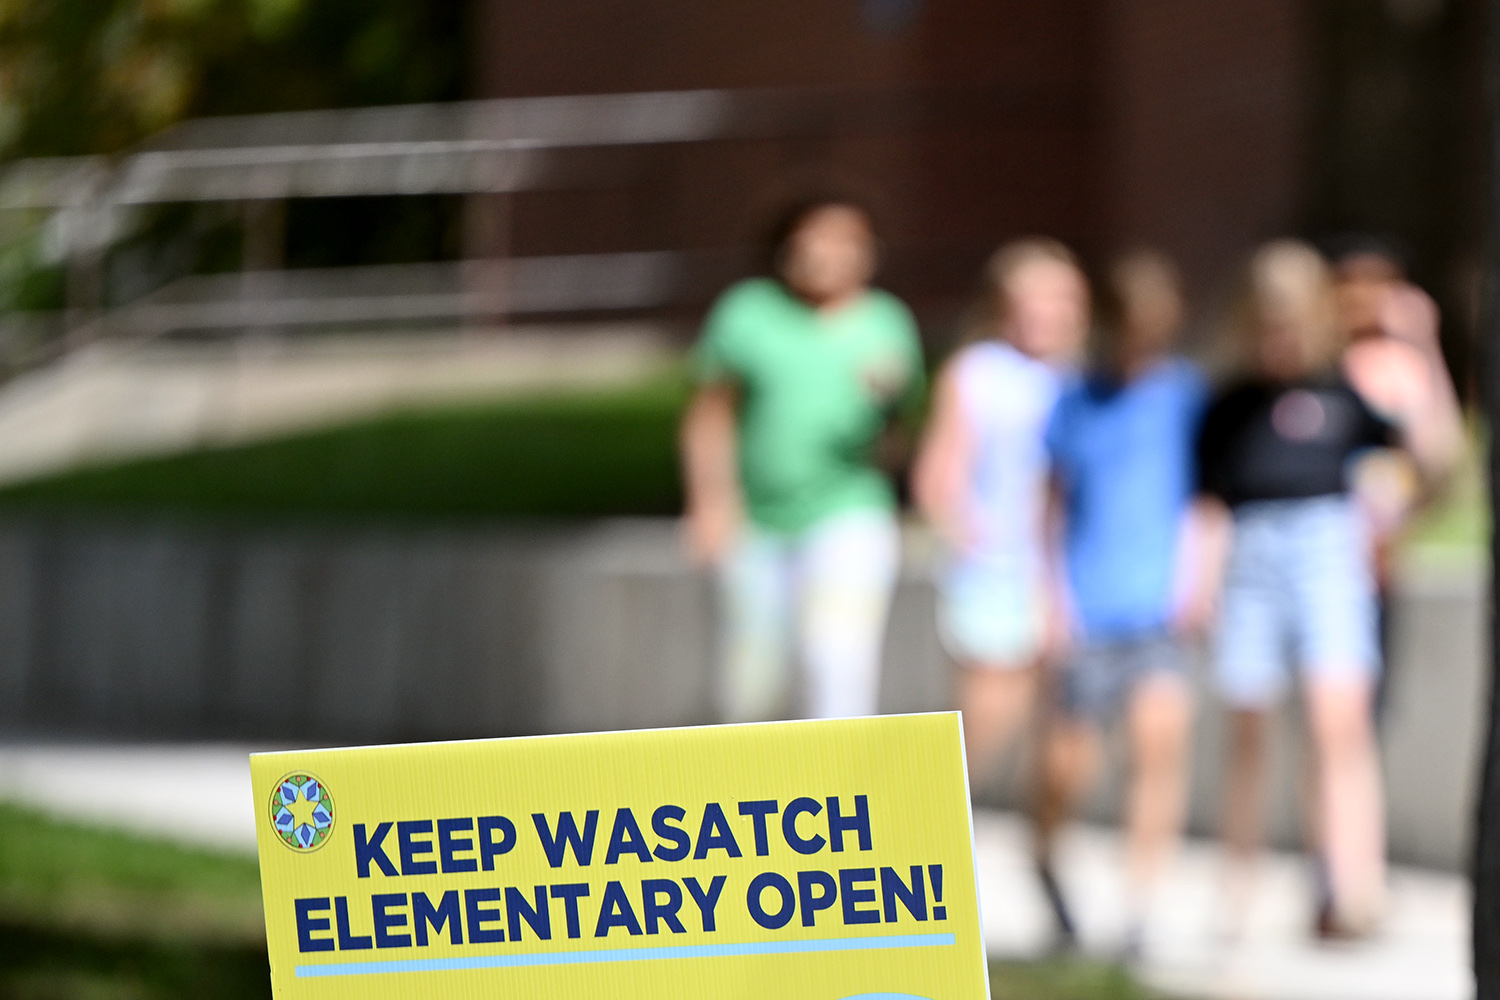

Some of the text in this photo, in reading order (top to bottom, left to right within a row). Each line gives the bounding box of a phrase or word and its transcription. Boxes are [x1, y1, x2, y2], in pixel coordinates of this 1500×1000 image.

[353, 795, 872, 878] KEEP WASATCH
[294, 864, 947, 953] ELEMENTARY OPEN!
